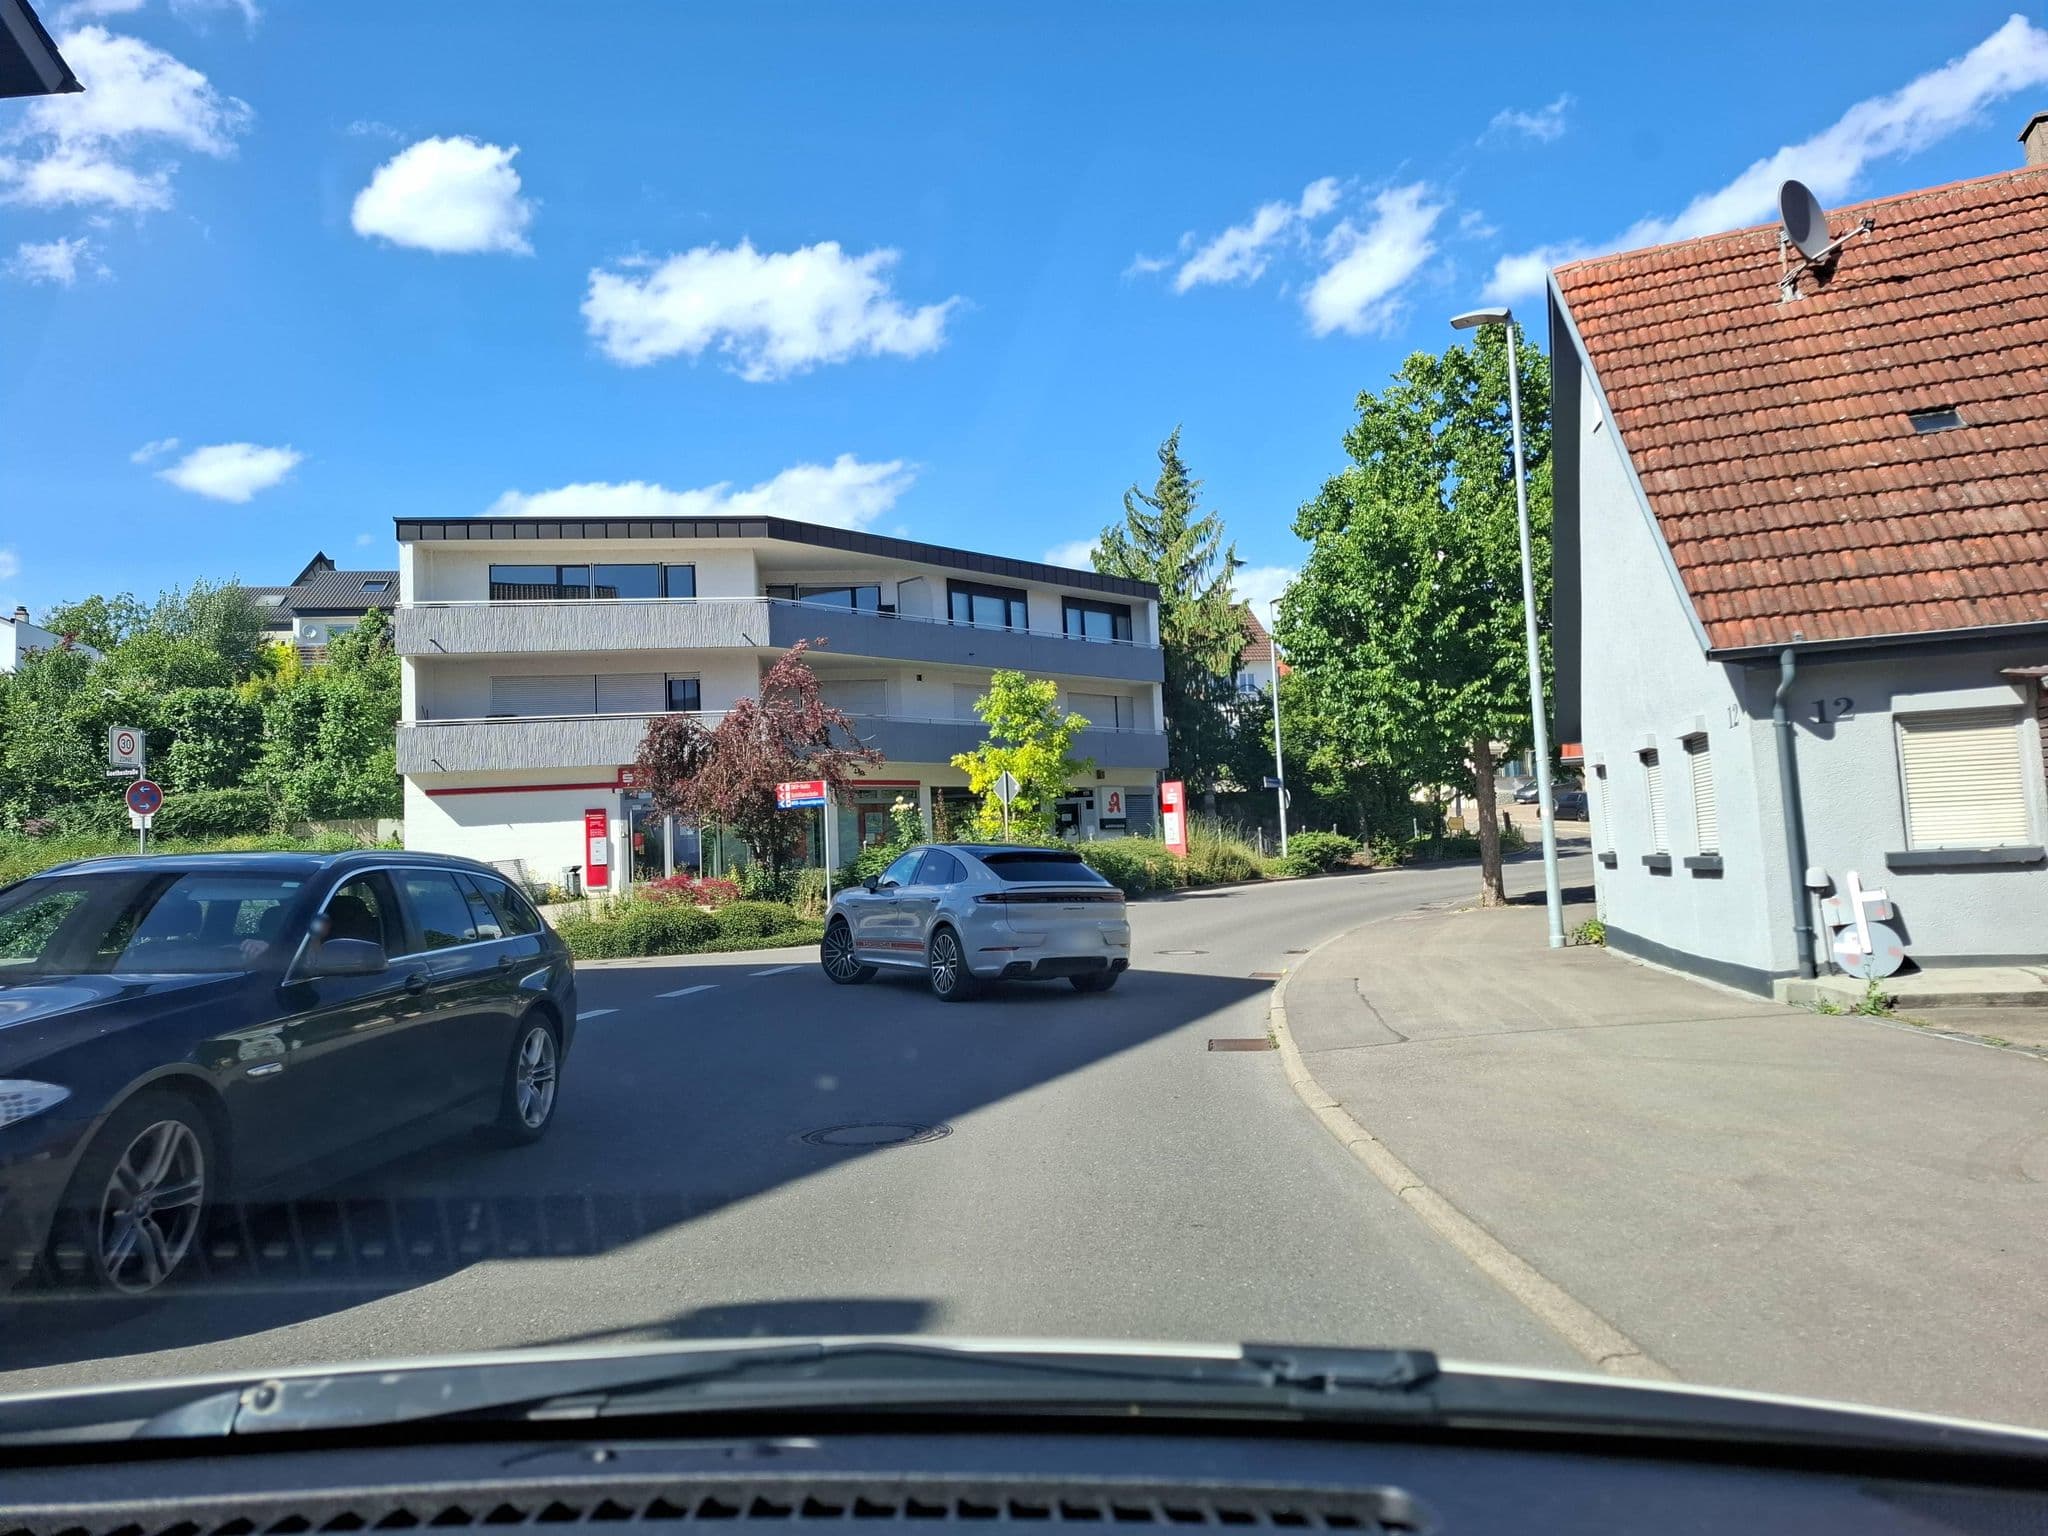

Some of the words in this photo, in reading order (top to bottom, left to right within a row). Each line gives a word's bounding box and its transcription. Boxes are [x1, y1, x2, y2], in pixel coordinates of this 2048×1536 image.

[1727, 703, 1739, 730] 12
[1809, 697, 1854, 724] 12
[120, 738, 132, 750] 30
